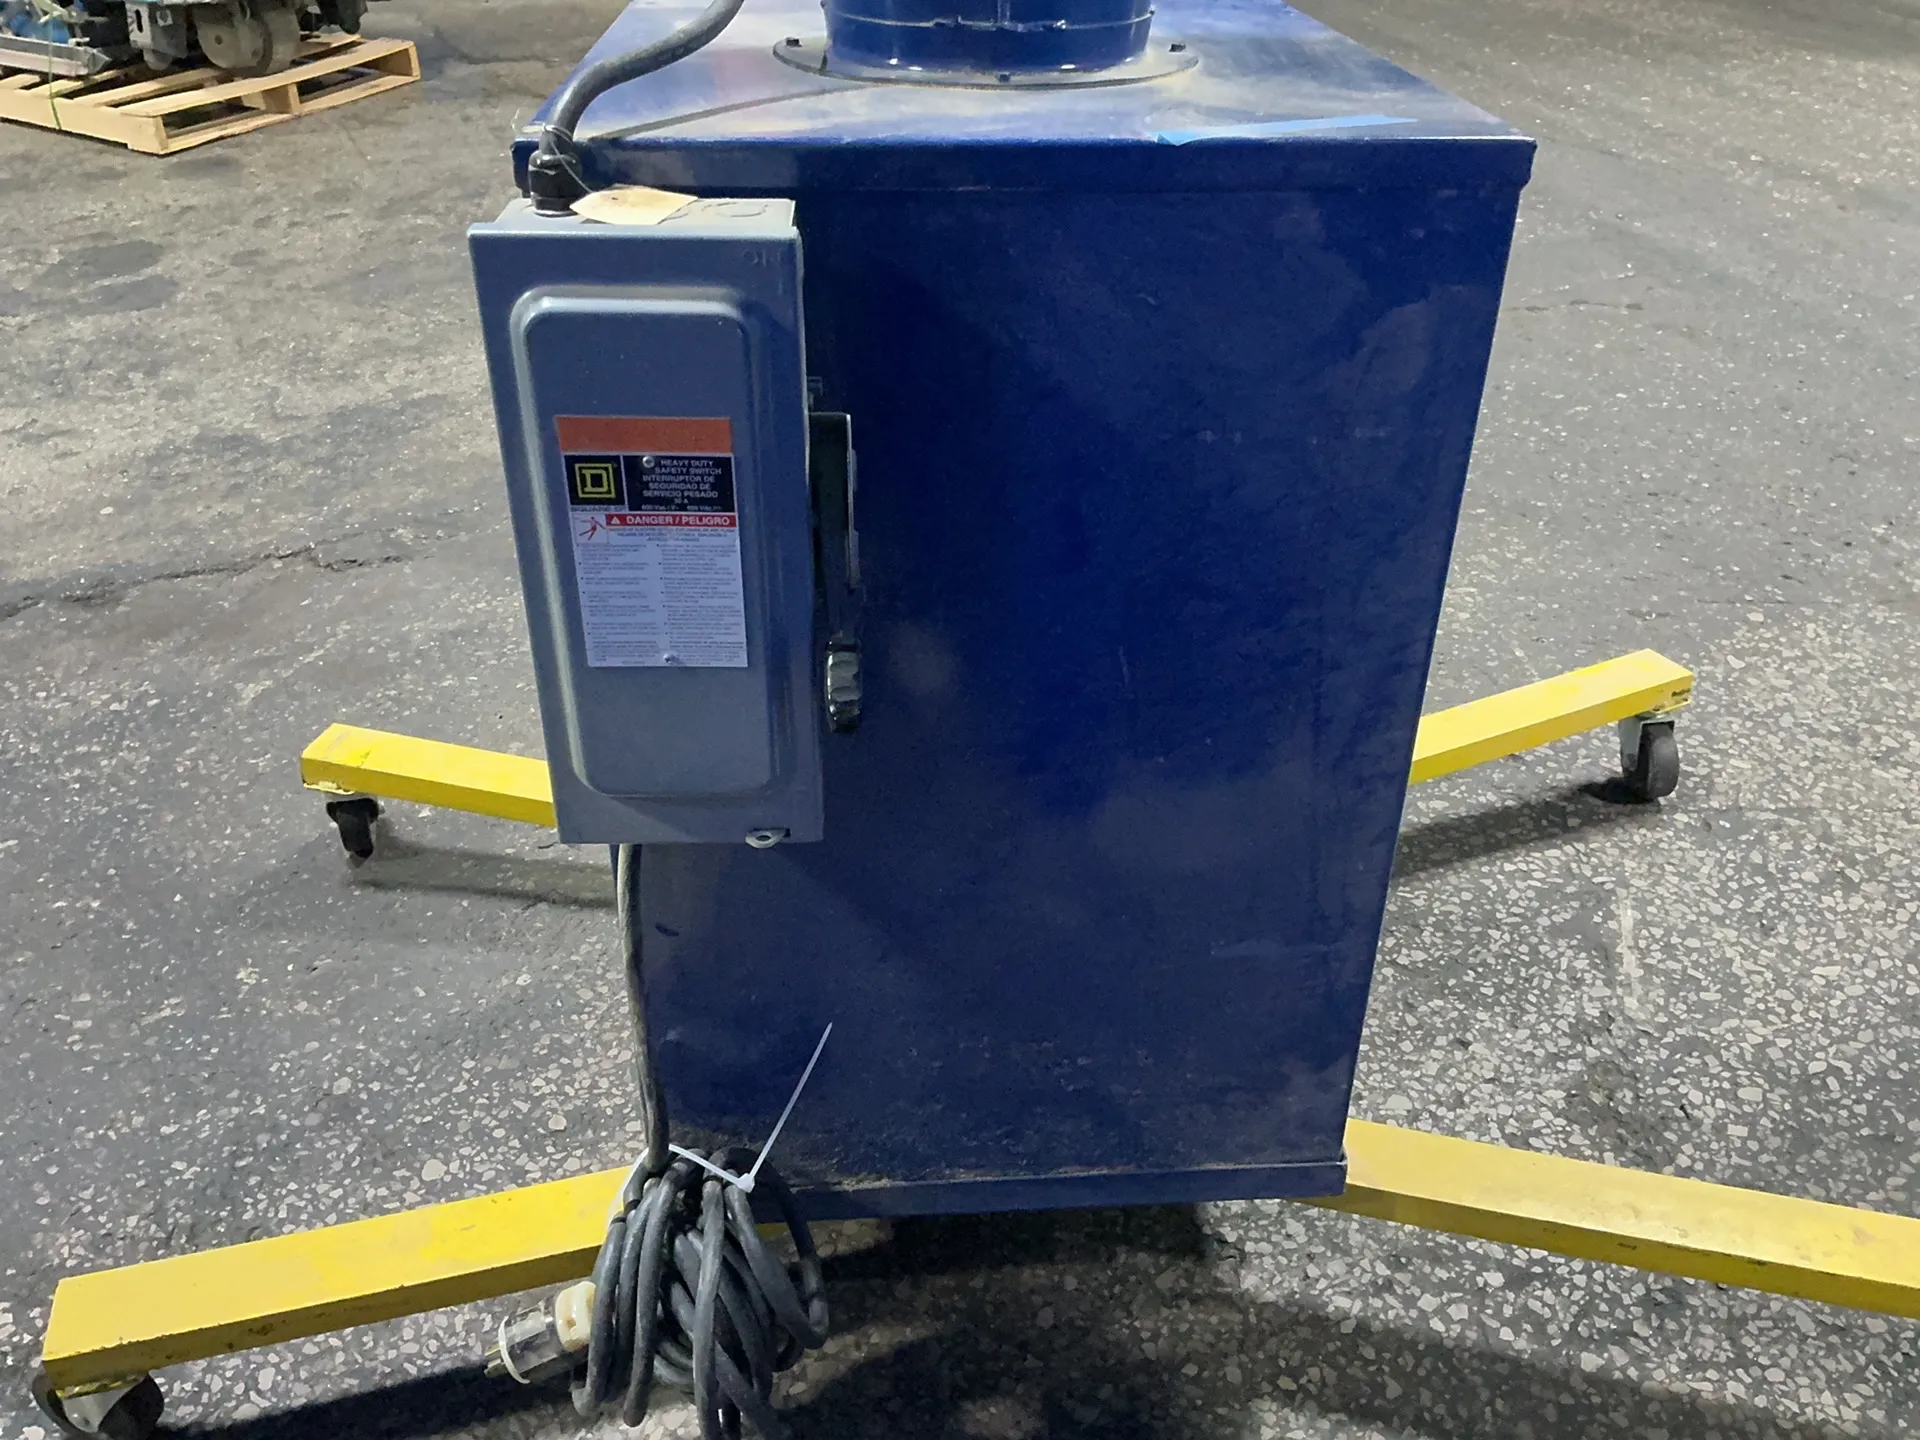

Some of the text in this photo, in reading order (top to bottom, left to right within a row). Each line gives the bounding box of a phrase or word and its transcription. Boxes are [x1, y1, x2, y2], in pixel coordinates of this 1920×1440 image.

[689, 467, 722, 475] SWITCH
[642, 474, 715, 483] INTERRUPTOR DE
[648, 482, 698, 490] SEGURIDAD
[683, 490, 719, 498] PESADO
[626, 515, 730, 525] DANGER / PELIGRO
